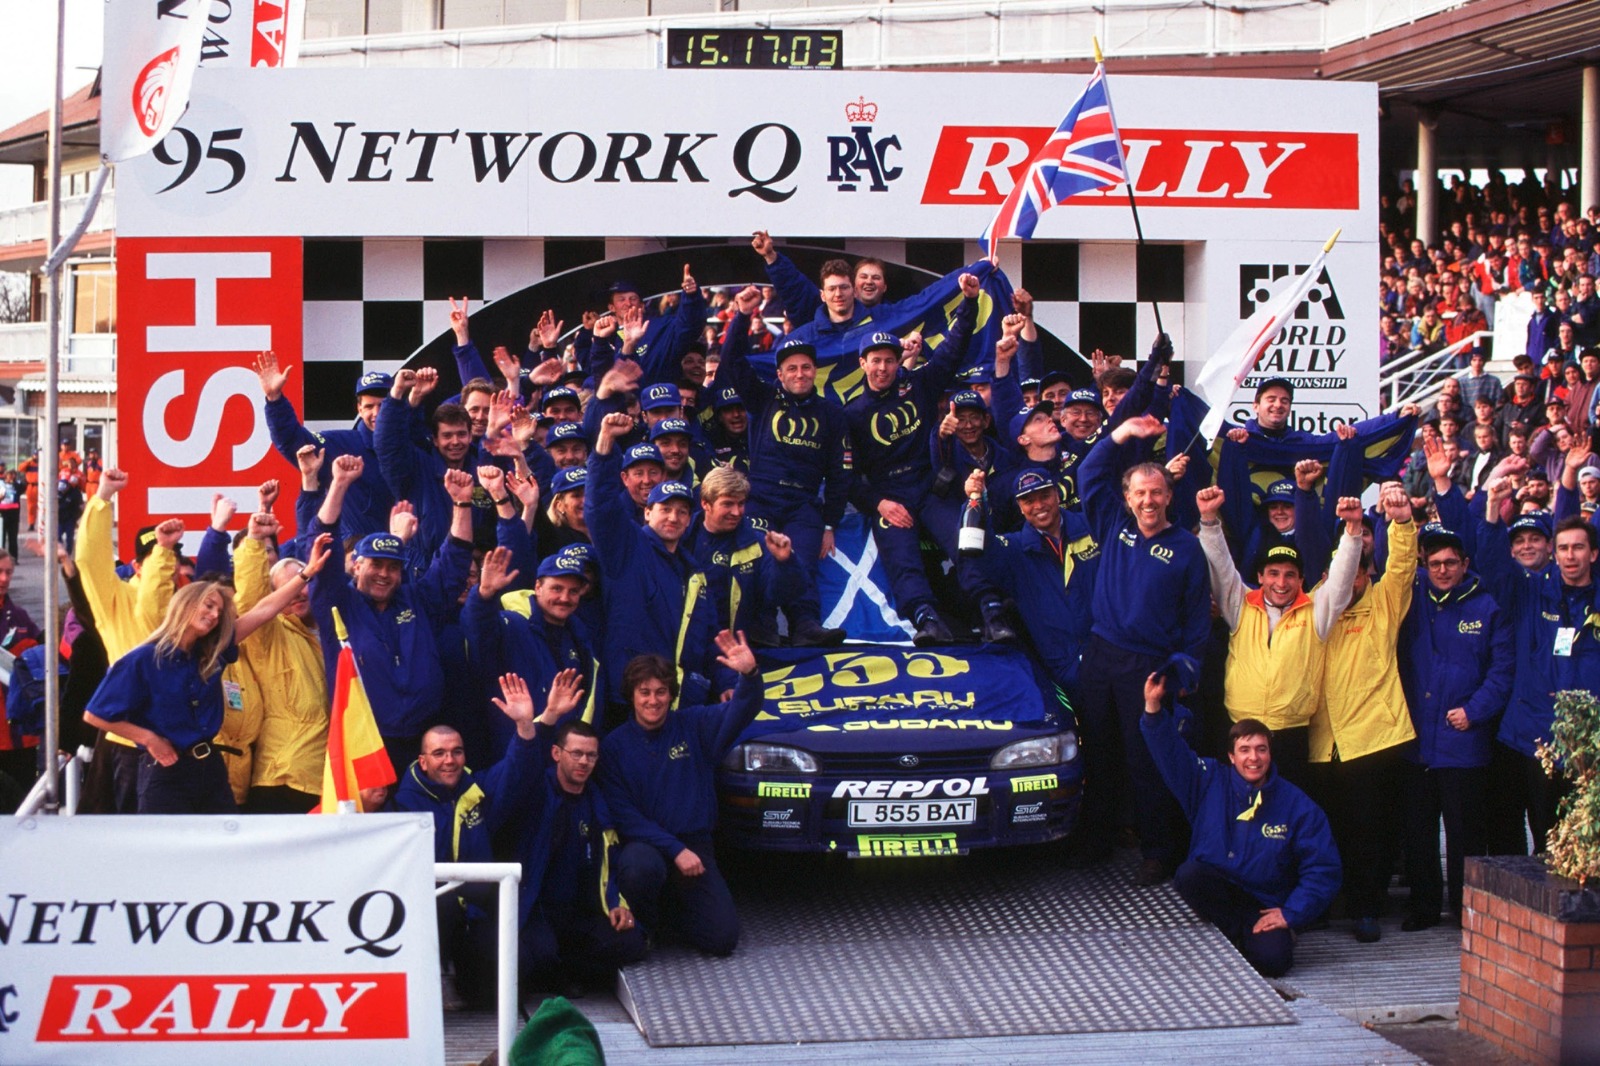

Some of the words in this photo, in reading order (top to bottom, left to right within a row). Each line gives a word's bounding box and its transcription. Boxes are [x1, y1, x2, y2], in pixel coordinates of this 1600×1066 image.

[686, 35, 838, 66] 15.17.03
[275, 122, 718, 184] NETWORK
[728, 123, 801, 203] Q
[827, 126, 903, 192] RAC
[948, 136, 1306, 200] RLLY
[1269, 325, 1346, 346] ORLD
[1233, 409, 1359, 434] Slptor
[782, 435, 822, 449] SUBARU
[758, 781, 812, 798] PIRELLI
[831, 777, 990, 798] REPSOL
[1010, 773, 1058, 793] PIRELLI
[854, 805, 867, 823] L
[875, 804, 920, 823] 555
[927, 802, 972, 821] BAT
[857, 832, 959, 857] PIRELLI
[344, 890, 406, 958] Q
[58, 982, 378, 1035] RALLY
